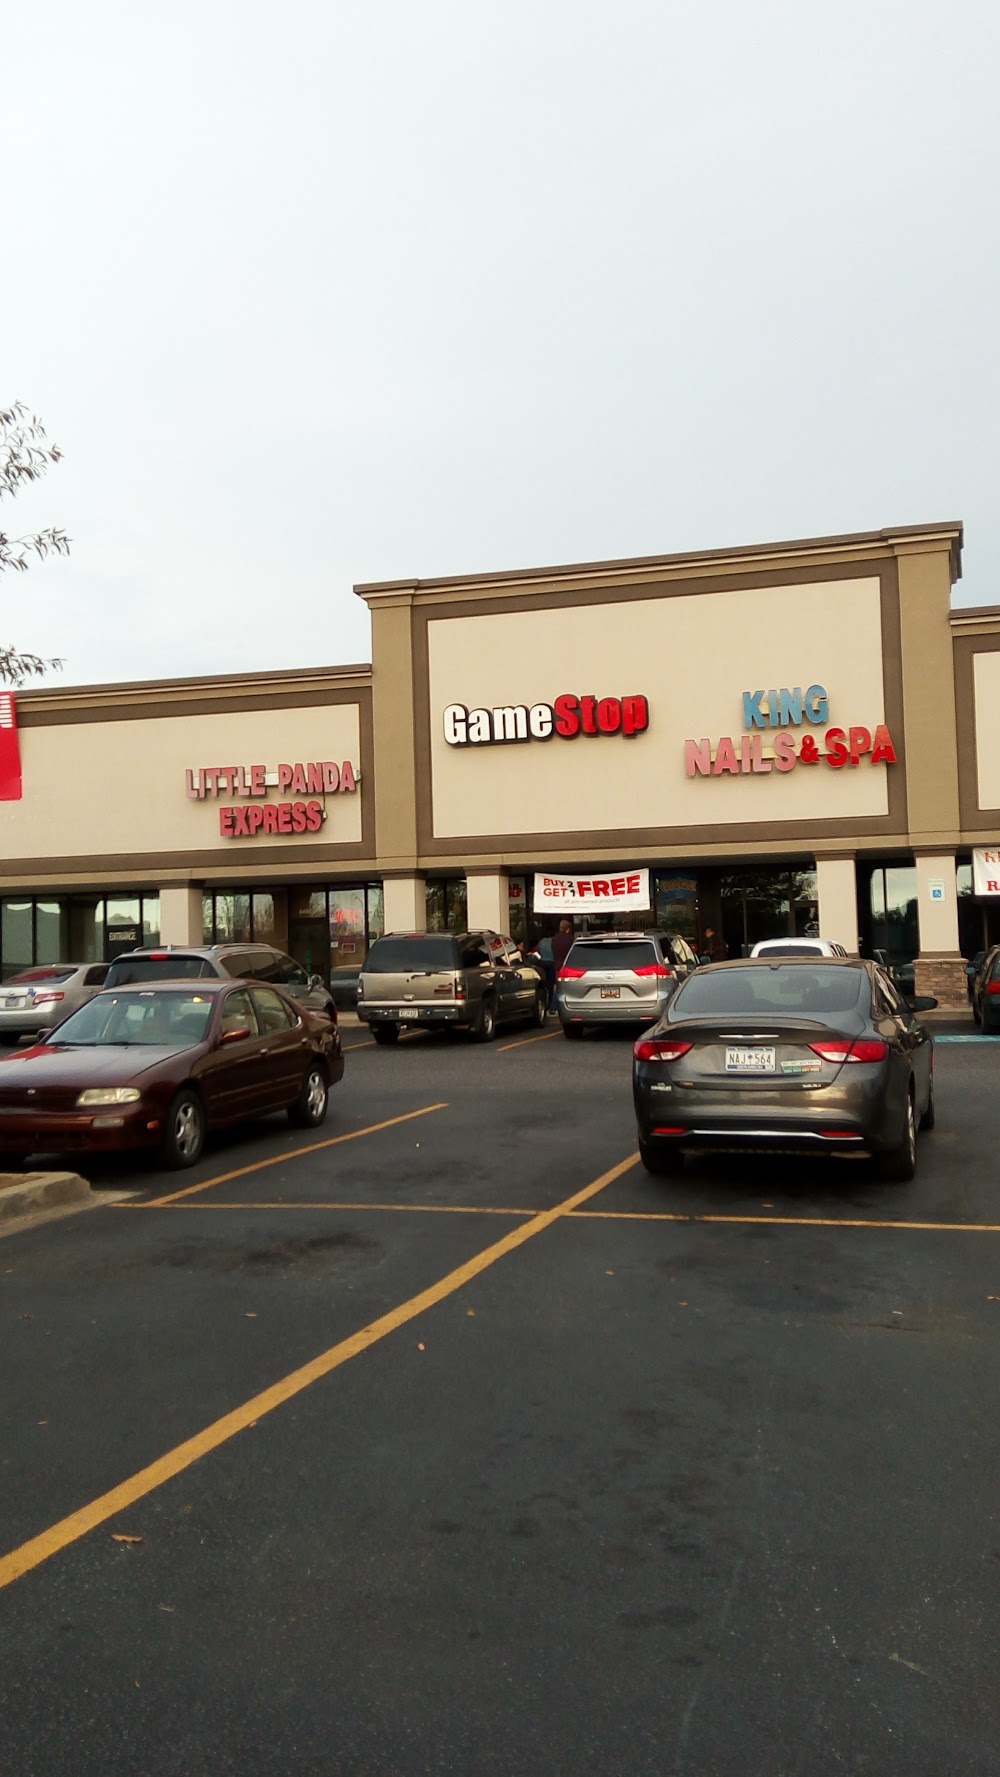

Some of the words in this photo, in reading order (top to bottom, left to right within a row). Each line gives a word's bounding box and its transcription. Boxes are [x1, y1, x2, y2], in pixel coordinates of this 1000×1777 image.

[742, 684, 829, 729] KING
[443, 693, 649, 746] GameStop
[185, 764, 267, 799] LITTLE
[278, 760, 356, 794] PANDA
[219, 800, 323, 837] EXPRESS
[543, 877, 565, 887] BUY
[543, 888, 567, 897] GET
[570, 889, 576, 897] 1
[577, 874, 641, 898] FREE
[986, 880, 1000, 892] R
[729, 1053, 746, 1065] NAJ
[754, 1053, 772, 1065] 564
